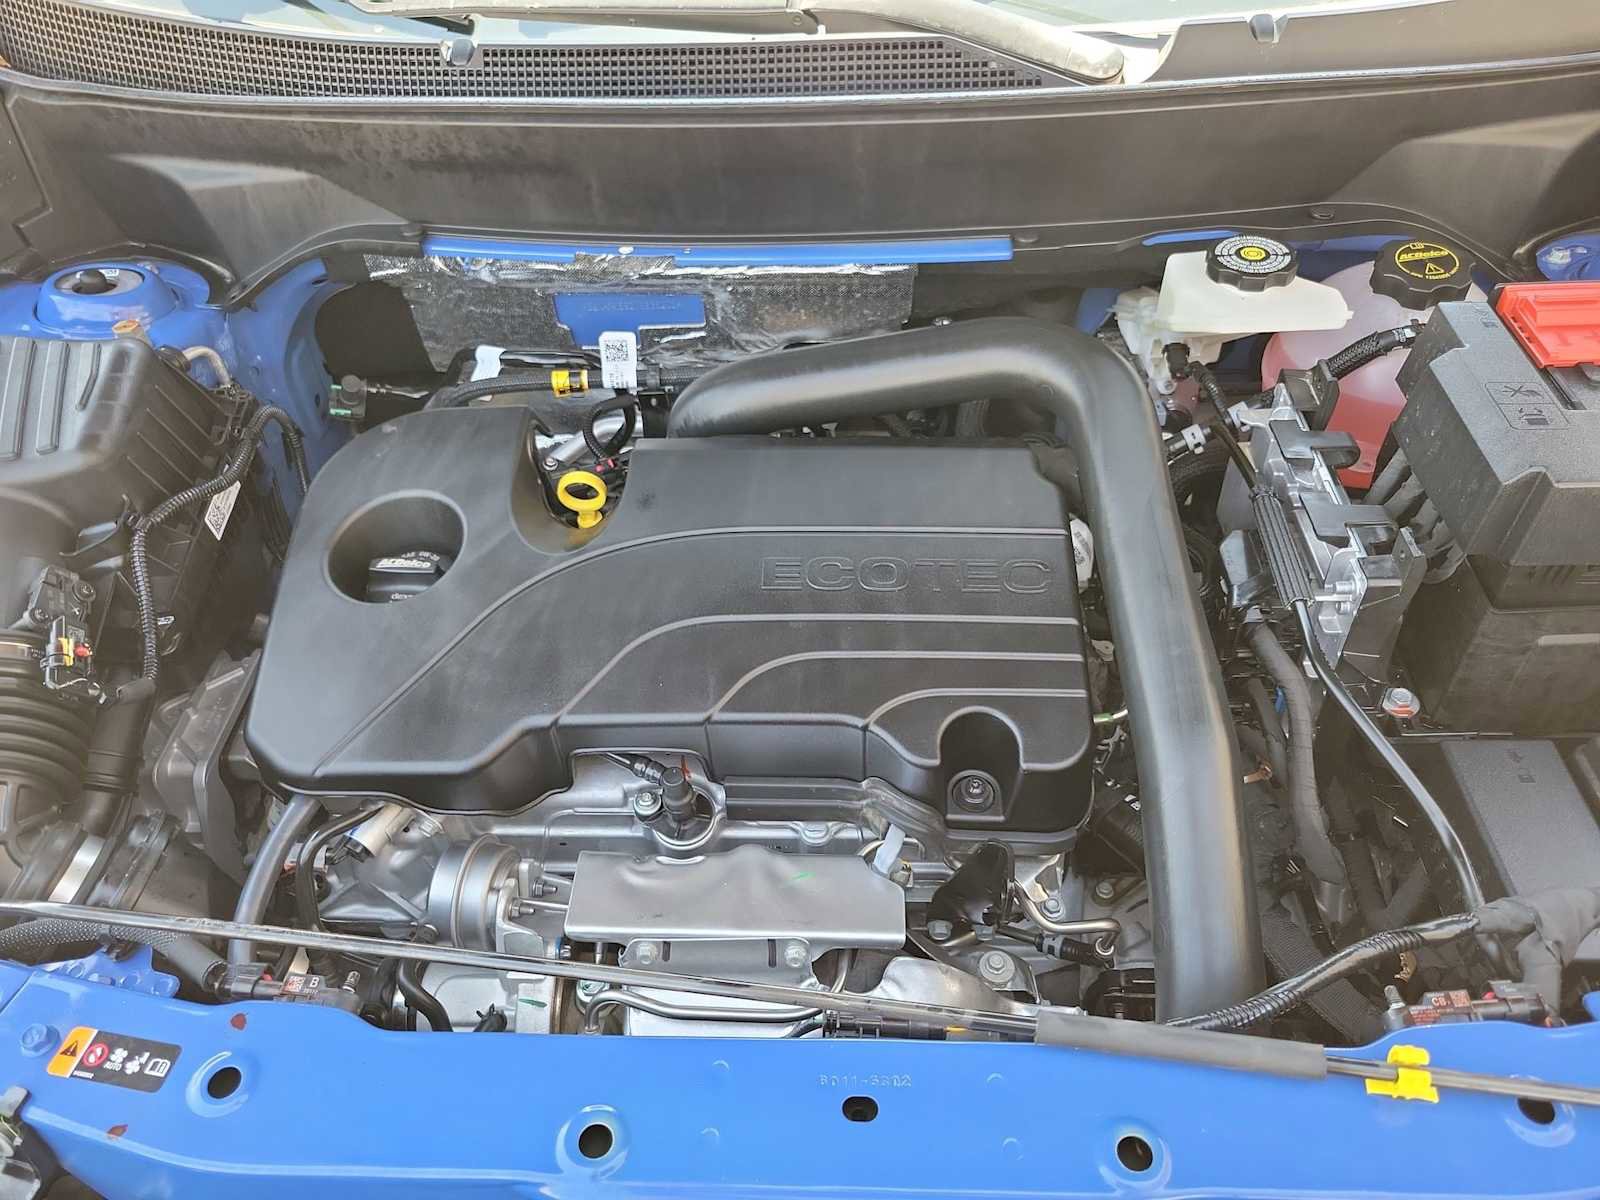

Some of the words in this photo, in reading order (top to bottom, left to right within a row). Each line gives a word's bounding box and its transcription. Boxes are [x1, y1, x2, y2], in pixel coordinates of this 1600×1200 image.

[376, 559, 431, 569] ACDelco
[760, 557, 1051, 594] ECOTEC
[103, 1061, 123, 1072] AUTO
